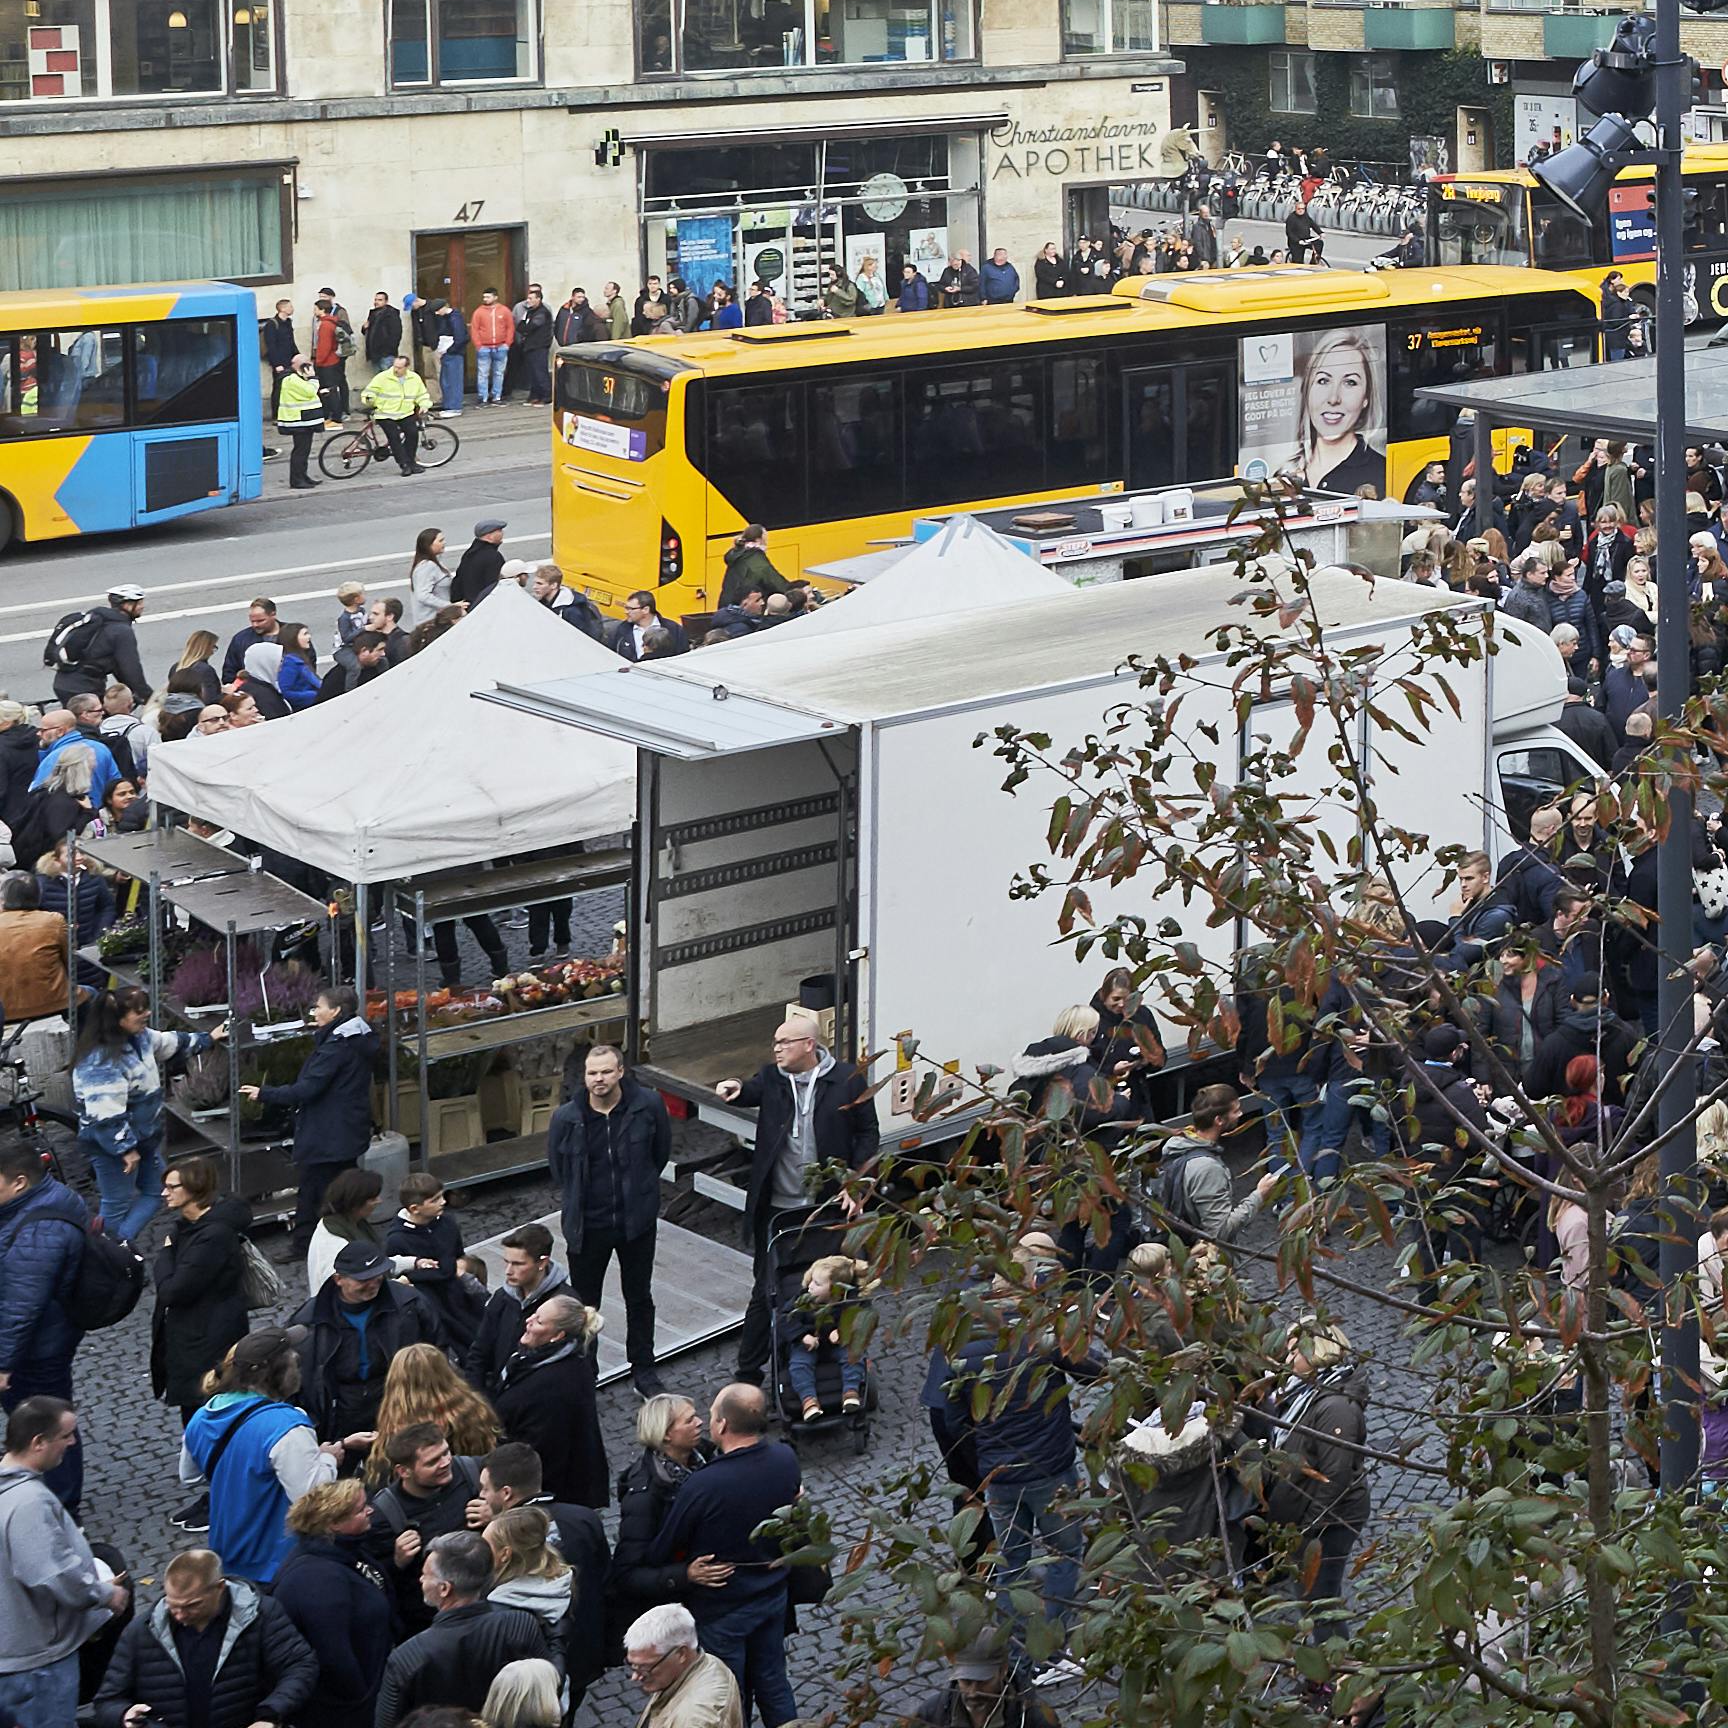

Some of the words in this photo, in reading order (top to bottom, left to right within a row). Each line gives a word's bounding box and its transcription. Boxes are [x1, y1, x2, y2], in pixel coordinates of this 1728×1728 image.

[991, 116, 1157, 147] Christianshavns
[992, 142, 1155, 181] APOTHEK
[453, 200, 486, 223] 47
[1407, 334, 1422, 350] 37
[603, 376, 615, 394] 37
[1244, 390, 1259, 402] JEG
[1244, 399, 1270, 412] PASSE
[1244, 409, 1266, 422] GODT
